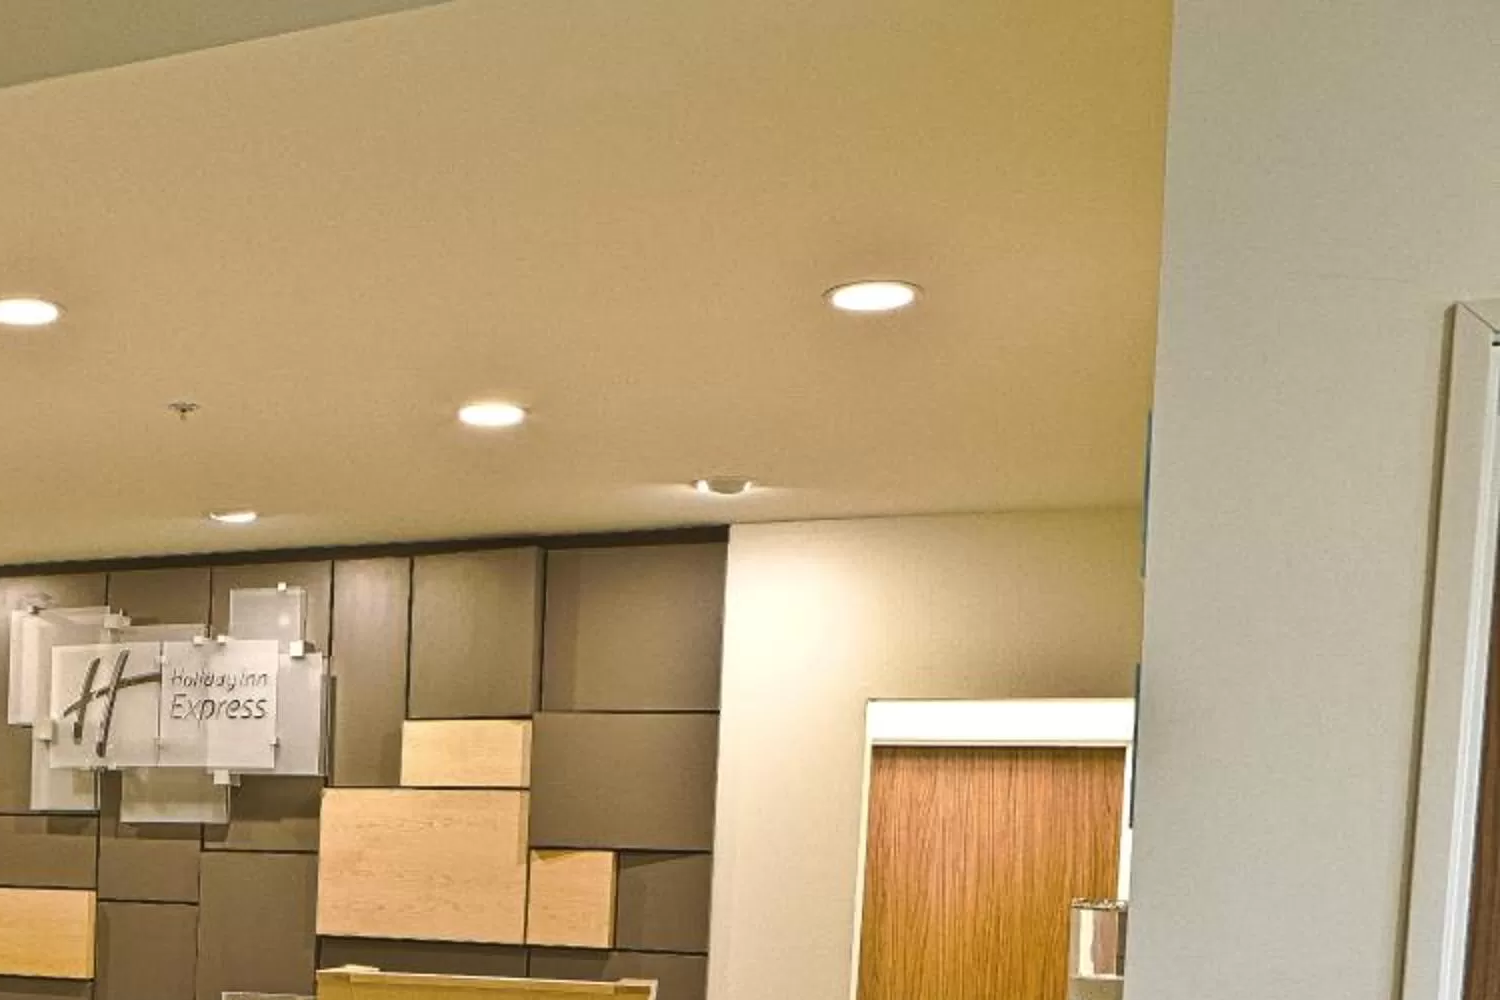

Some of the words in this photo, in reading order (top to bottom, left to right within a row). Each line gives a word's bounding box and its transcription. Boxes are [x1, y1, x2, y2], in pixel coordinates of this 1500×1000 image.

[170, 668, 236, 692] Holiday
[239, 671, 267, 688] Inn
[171, 693, 267, 722] Express
